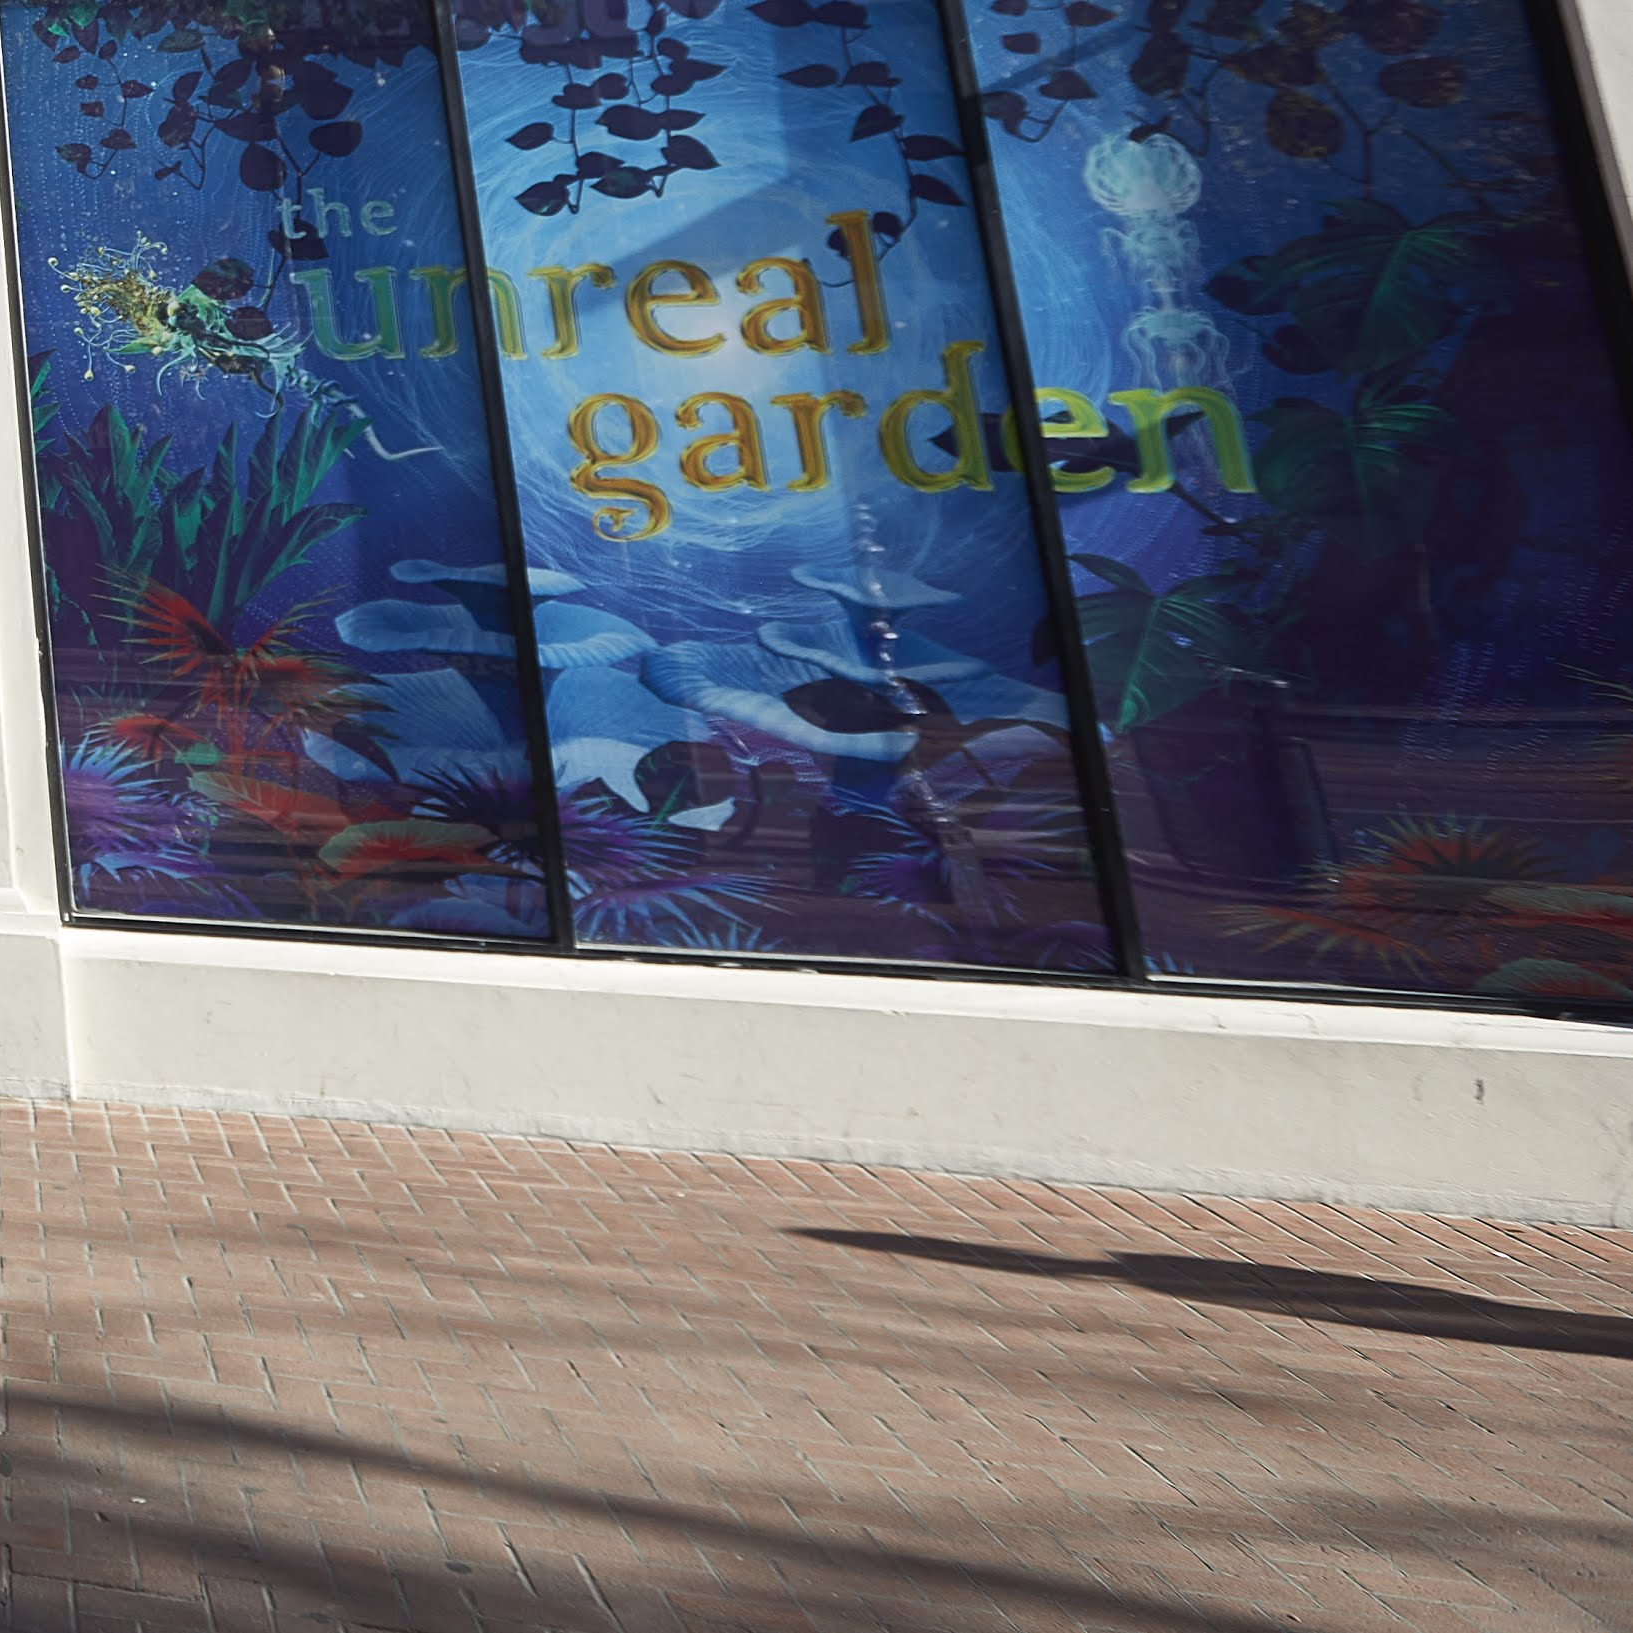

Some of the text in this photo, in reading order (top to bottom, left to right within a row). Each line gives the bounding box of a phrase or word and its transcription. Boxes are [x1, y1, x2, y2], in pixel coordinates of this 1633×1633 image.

[277, 187, 398, 239] the
[290, 209, 893, 362] unreal
[568, 341, 1257, 542] garden
